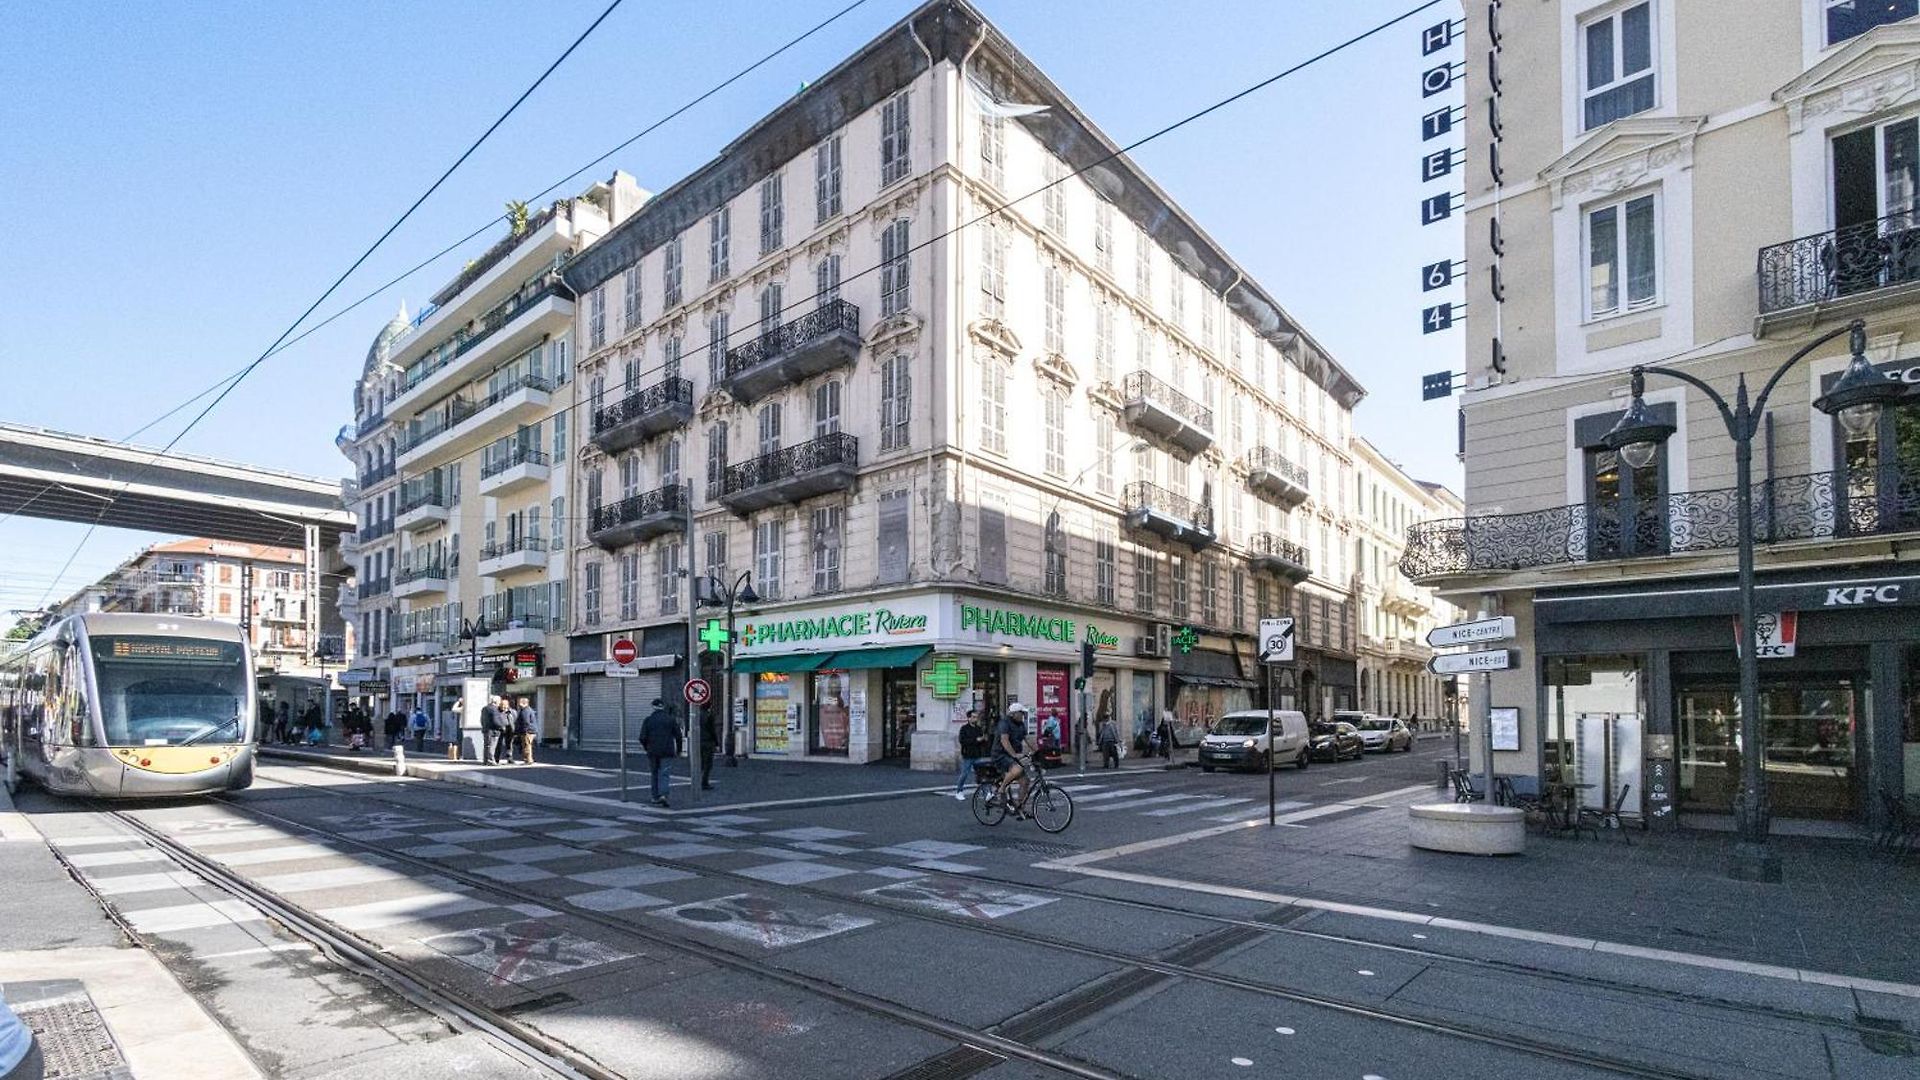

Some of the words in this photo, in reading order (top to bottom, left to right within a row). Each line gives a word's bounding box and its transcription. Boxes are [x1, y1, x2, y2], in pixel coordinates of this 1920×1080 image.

[1424, 22, 1450, 221] HOTEL
[1882, 366, 1920, 384] FC
[1823, 584, 1901, 606] KFC
[758, 612, 871, 644] PHARMACIE
[874, 607, 927, 635] Riviera
[961, 604, 1076, 643] PHARMACIE
[1270, 639, 1283, 650] 30
